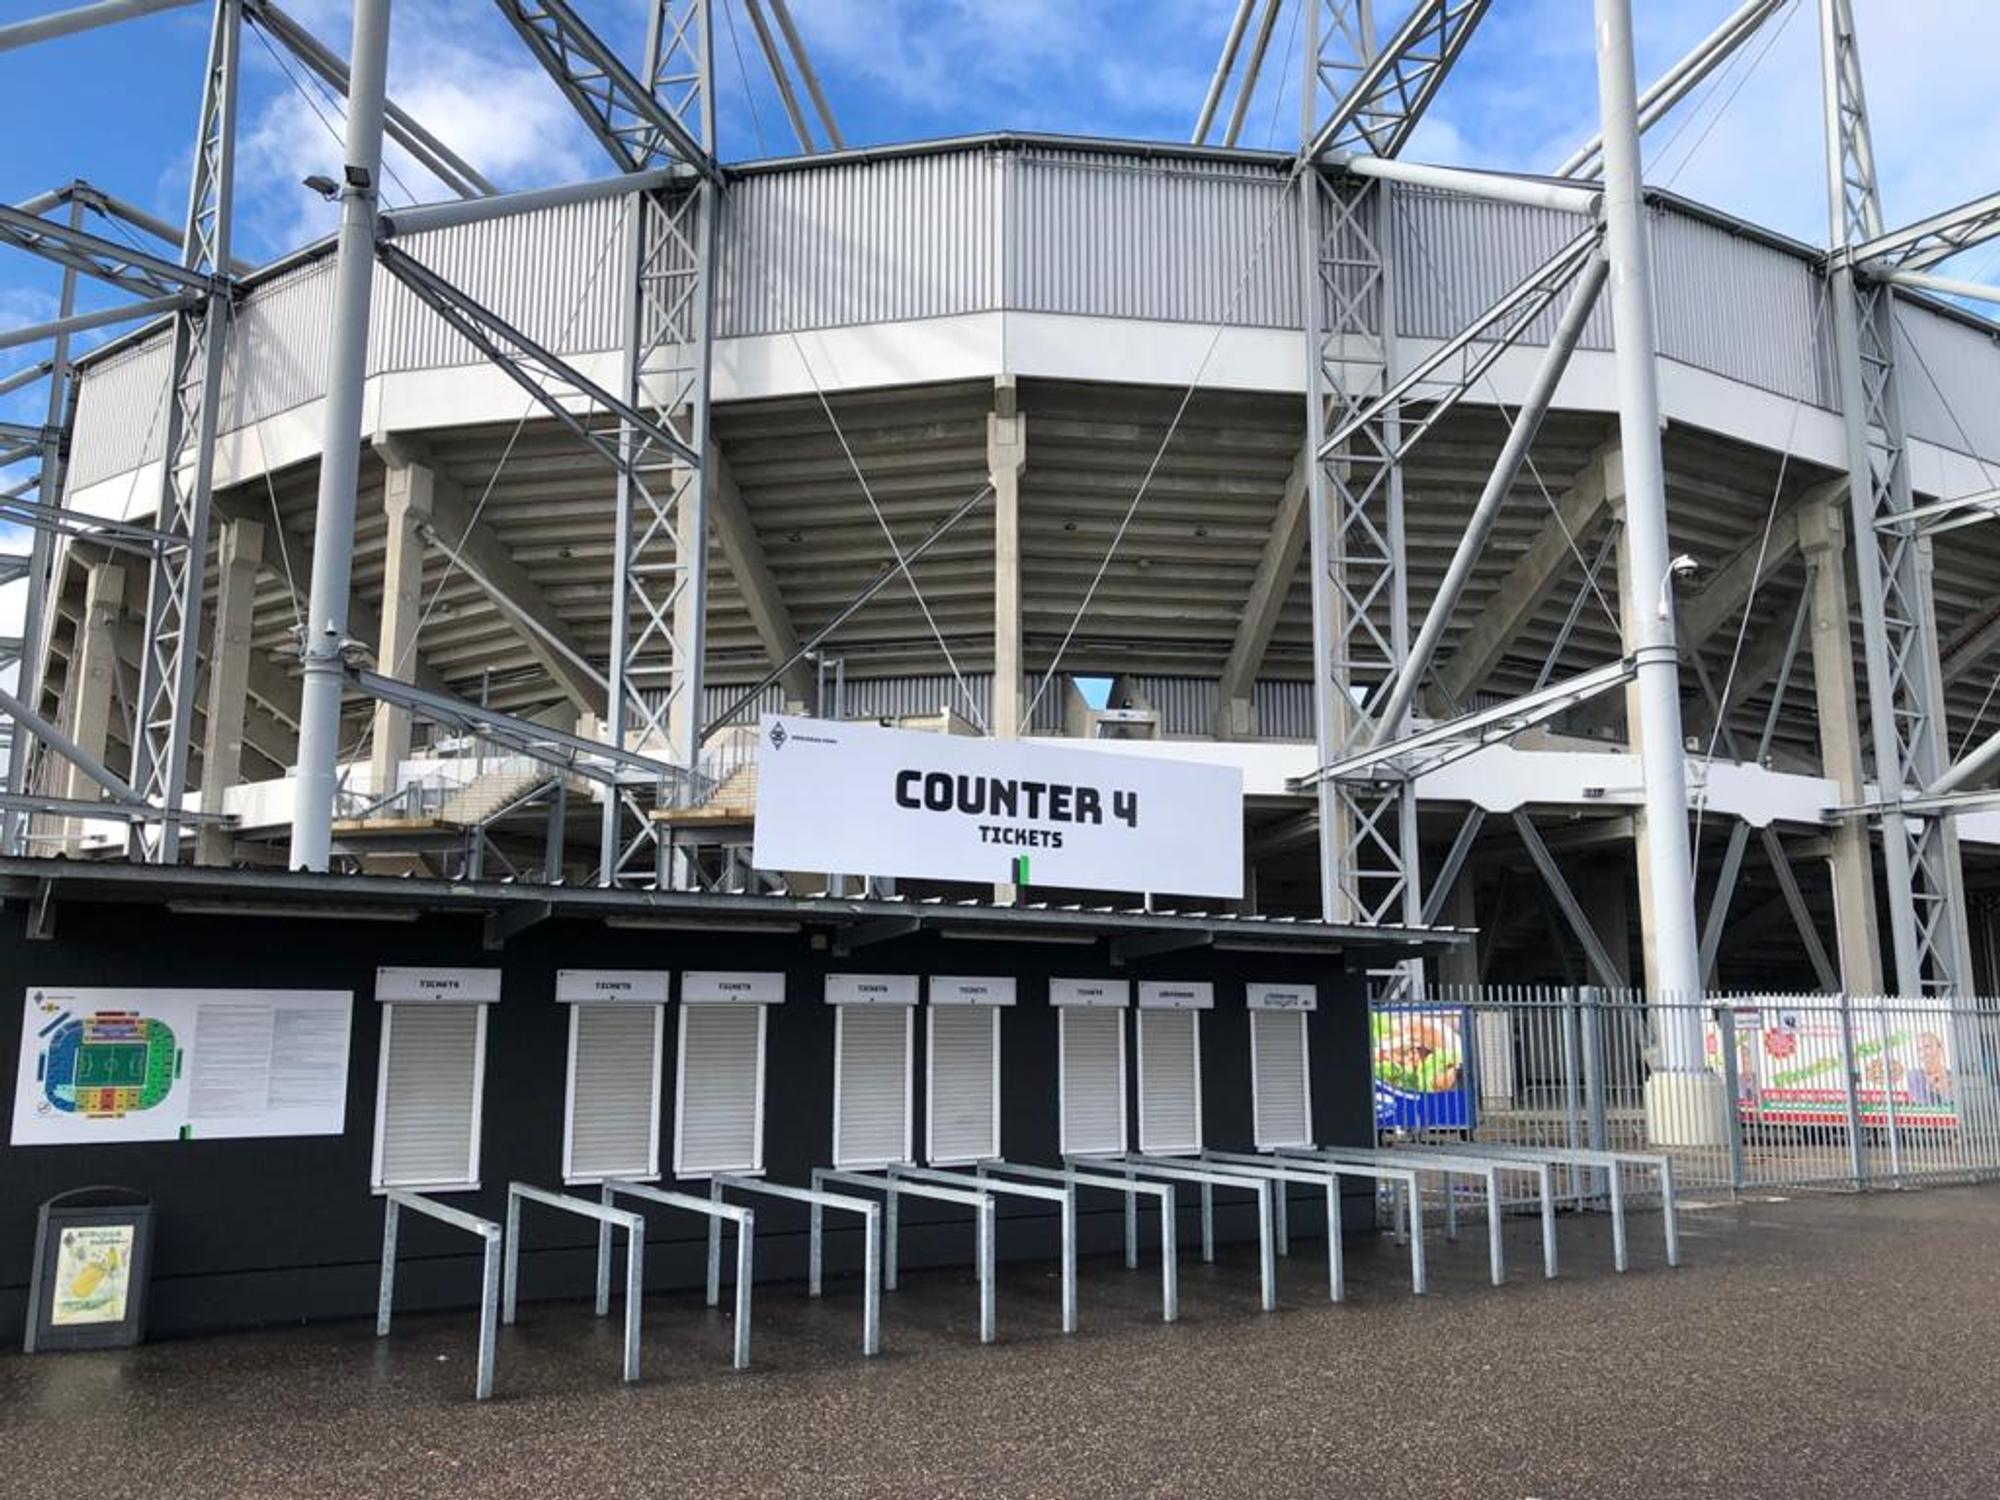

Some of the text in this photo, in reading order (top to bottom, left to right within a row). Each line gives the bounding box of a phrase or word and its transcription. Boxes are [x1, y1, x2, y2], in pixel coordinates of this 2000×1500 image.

[895, 769, 1137, 828] COUNTER 4
[979, 825, 1063, 849] TICKETS
